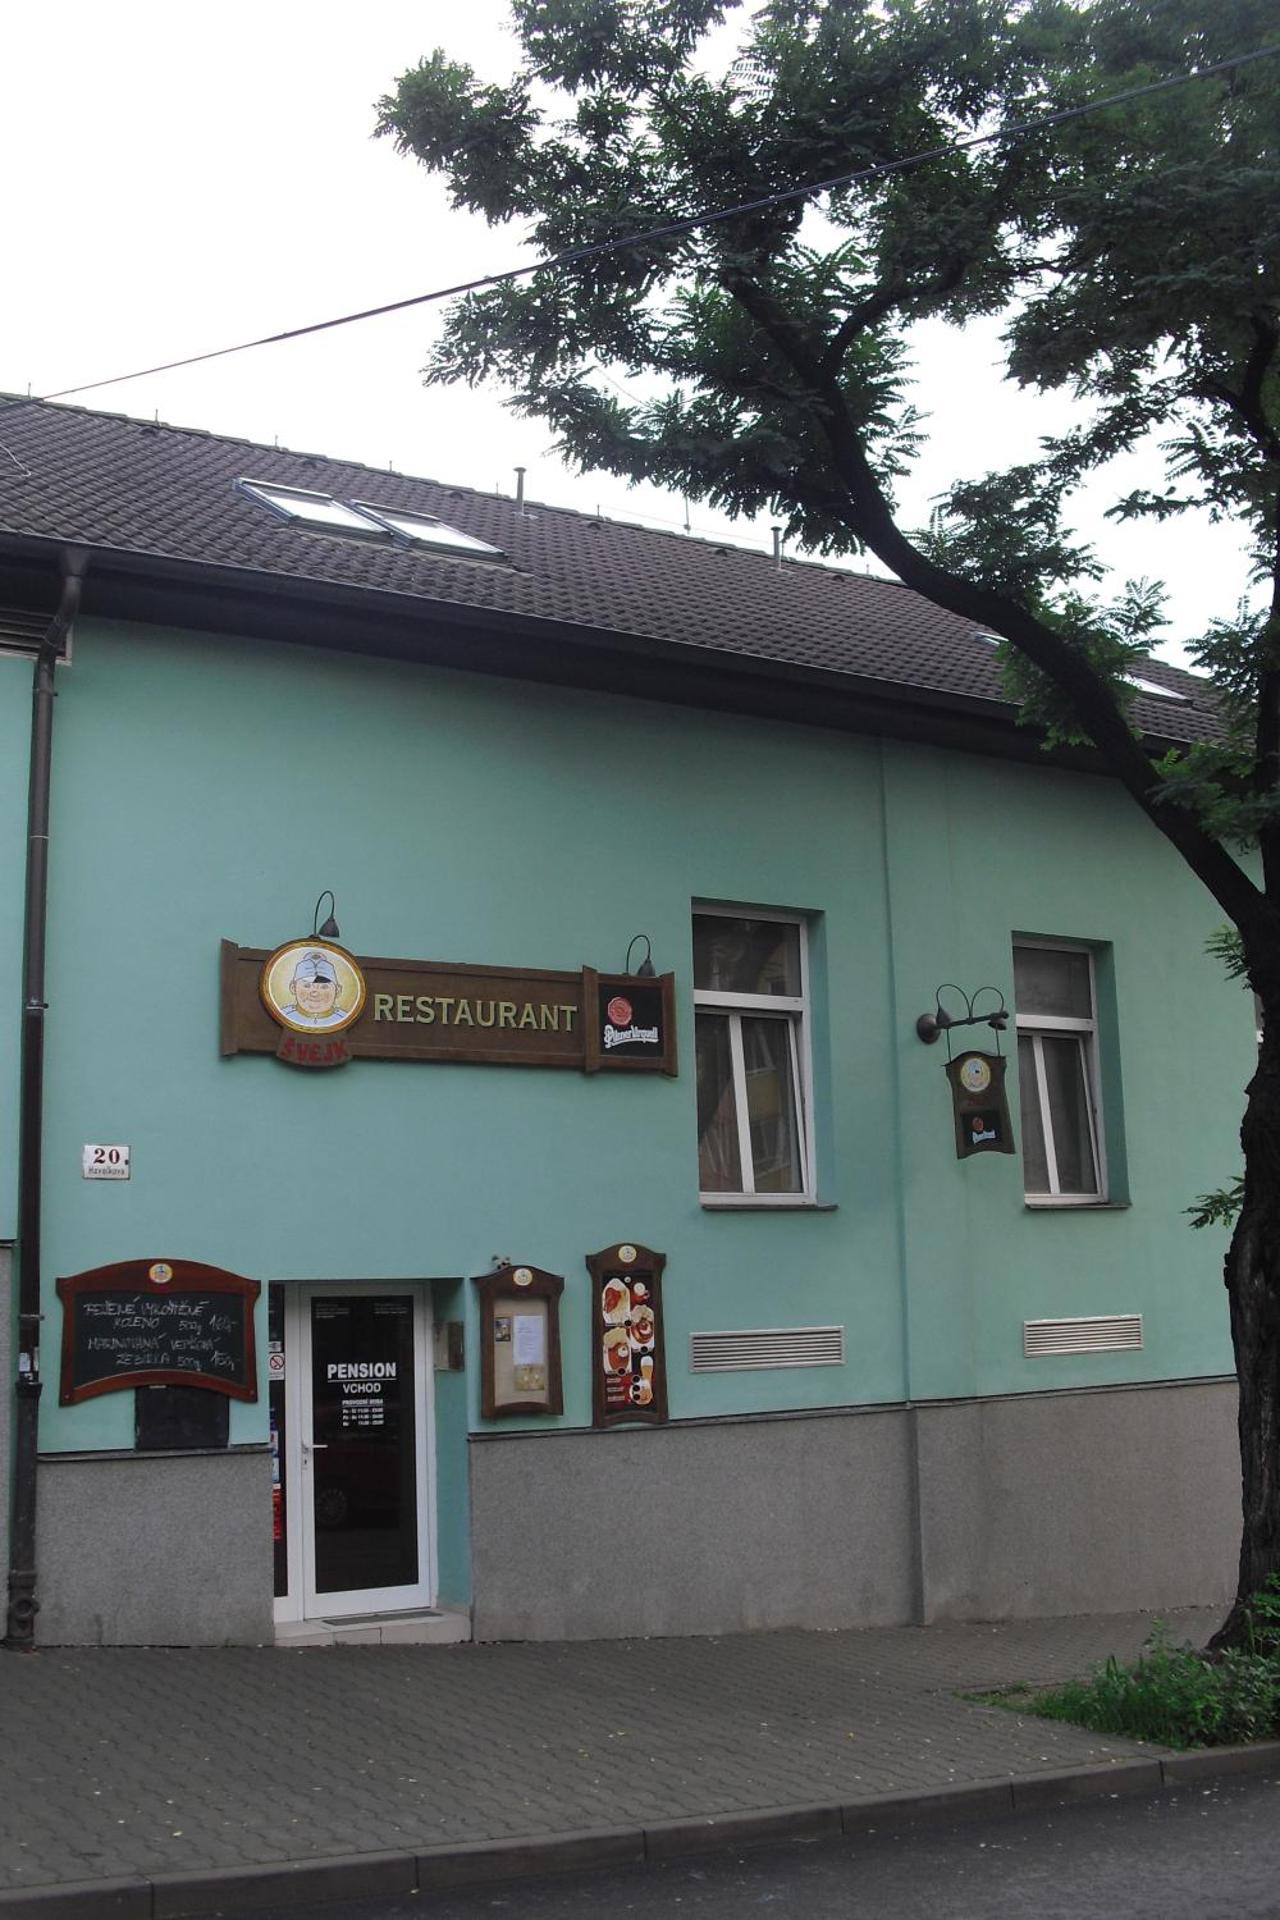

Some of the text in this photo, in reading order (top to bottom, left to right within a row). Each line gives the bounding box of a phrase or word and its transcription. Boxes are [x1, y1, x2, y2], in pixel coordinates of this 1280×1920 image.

[373, 993, 578, 1032] RESTAURANT
[93, 1147, 120, 1164] 20
[327, 1362, 397, 1379] PENSION
[342, 1382, 381, 1394] VCHOD
